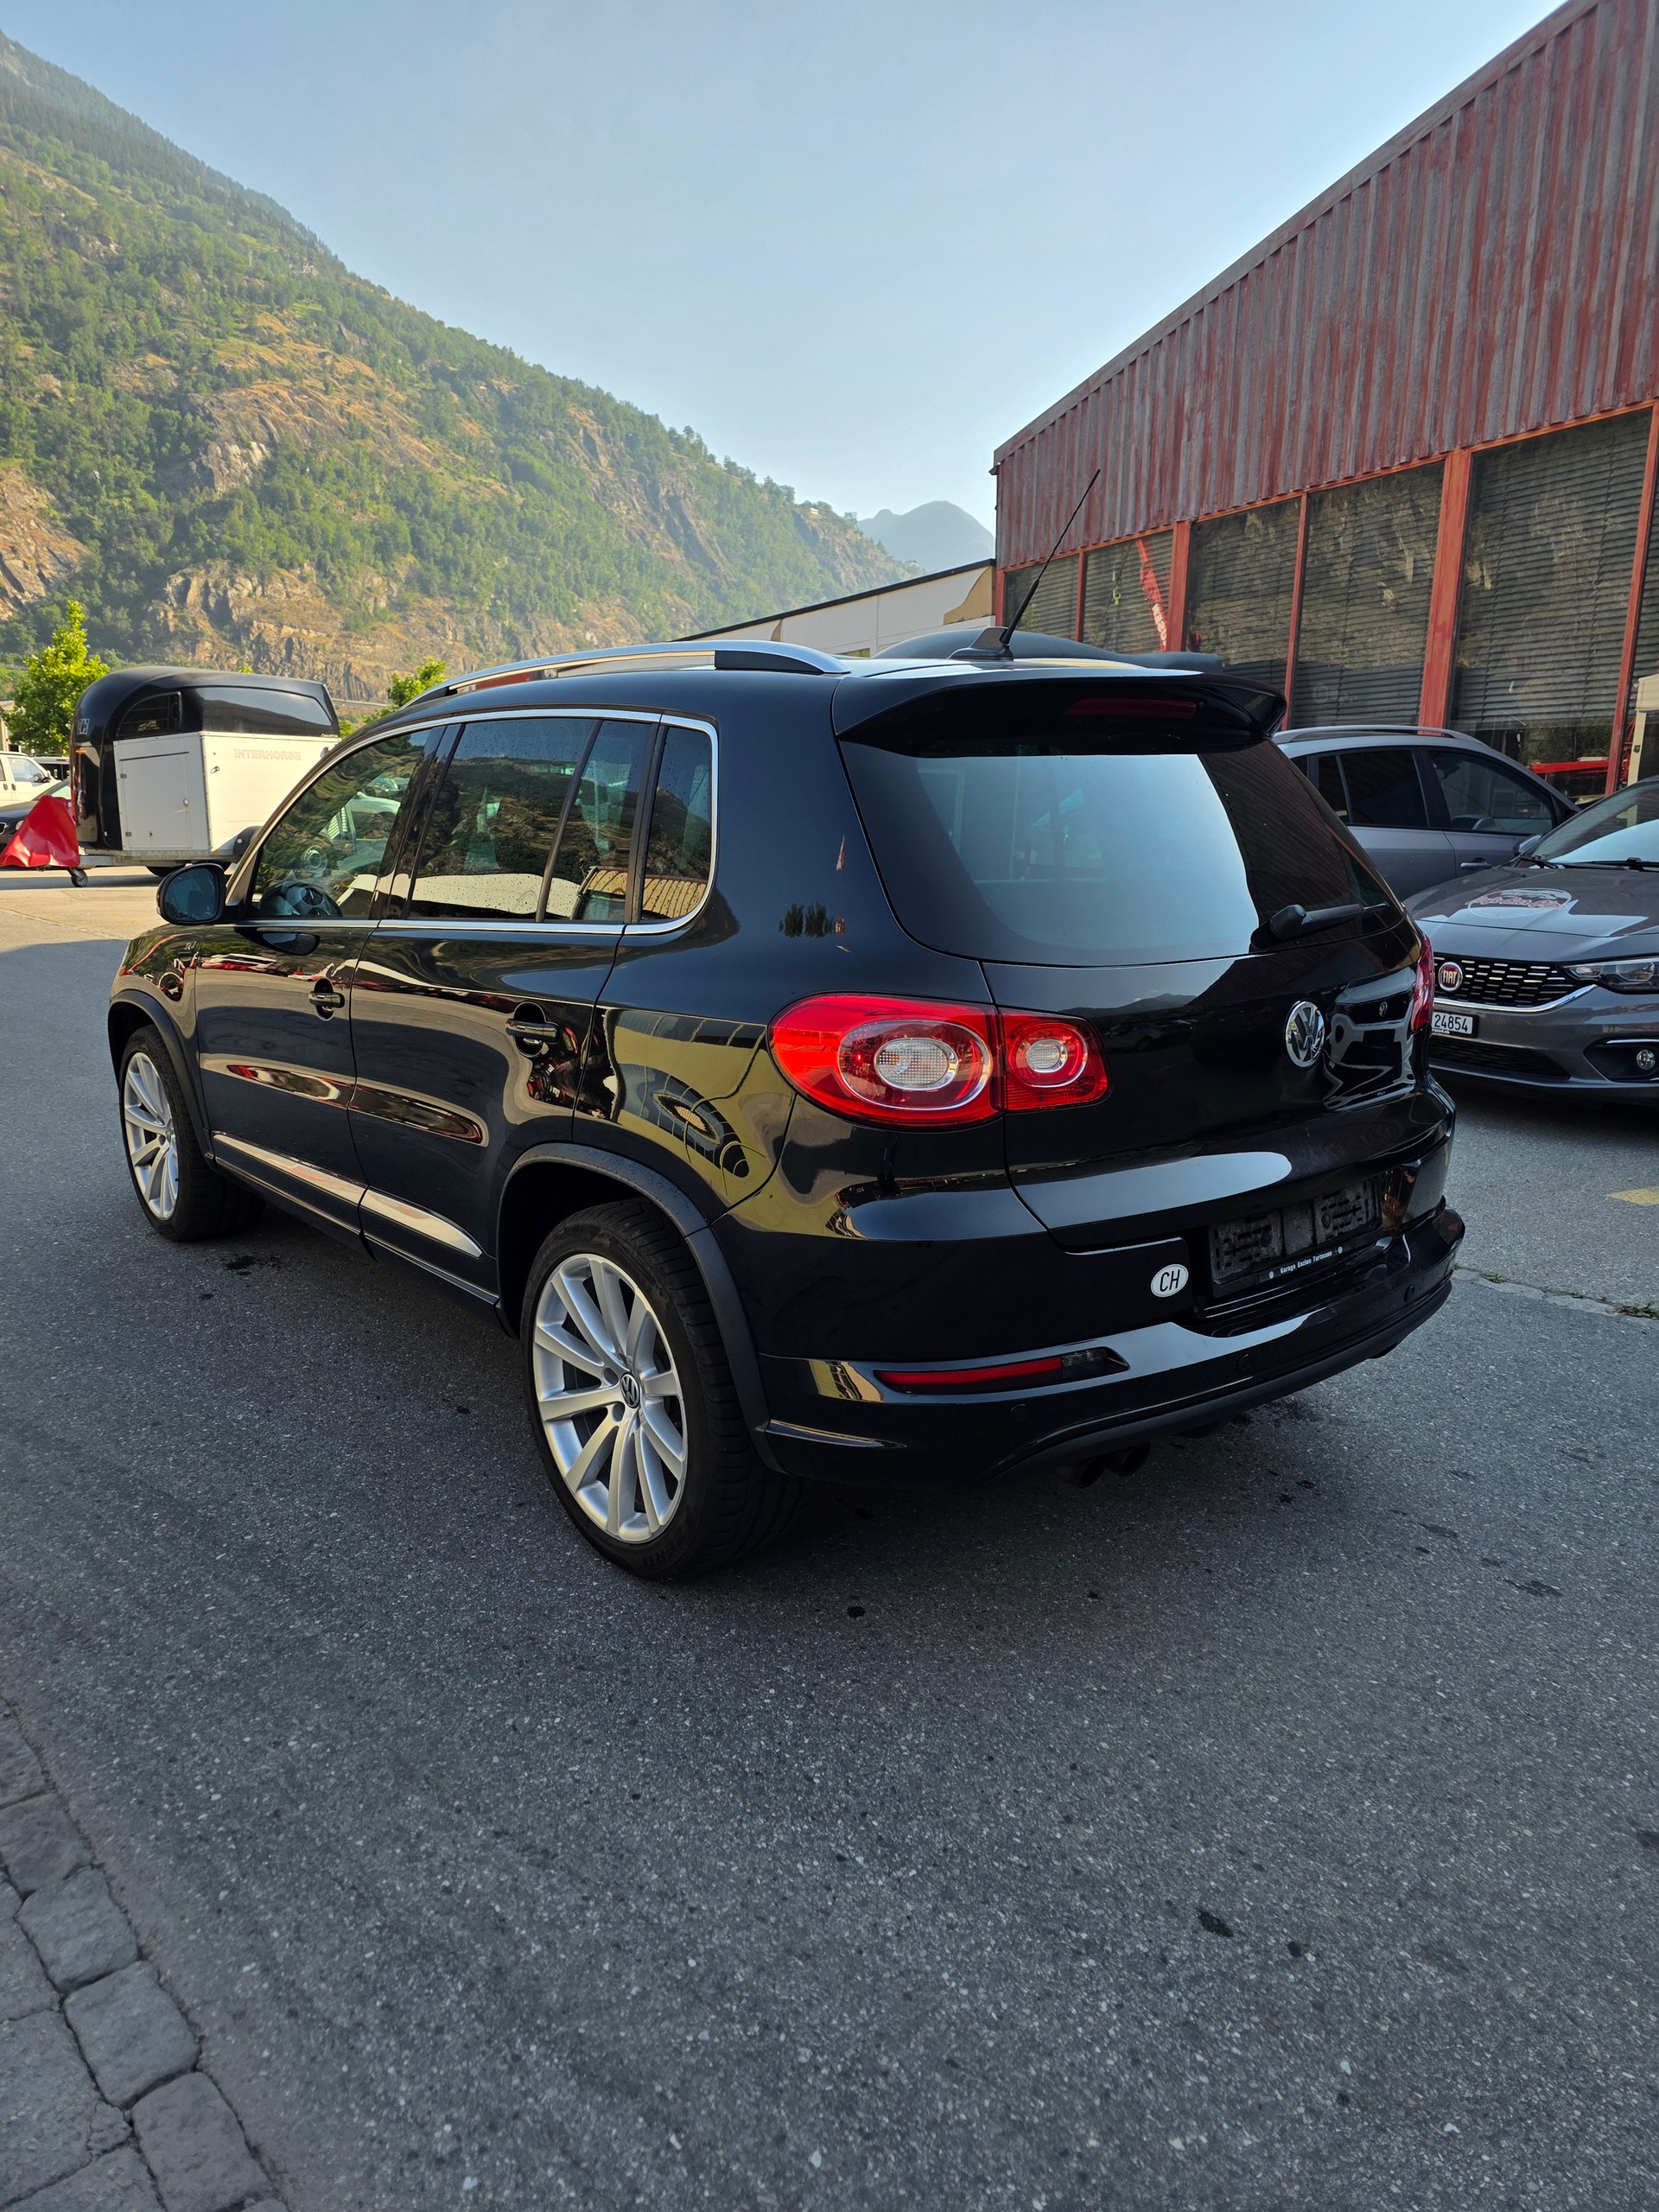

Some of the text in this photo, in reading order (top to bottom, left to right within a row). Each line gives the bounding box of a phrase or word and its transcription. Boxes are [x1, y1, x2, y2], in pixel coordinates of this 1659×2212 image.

[234, 748, 302, 760] INTERHORSE
[1443, 970, 1458, 984] FIAT
[1434, 1014, 1469, 1032] 24854
[1280, 1264, 1296, 1274] Garage
[1160, 1269, 1180, 1292] CH
